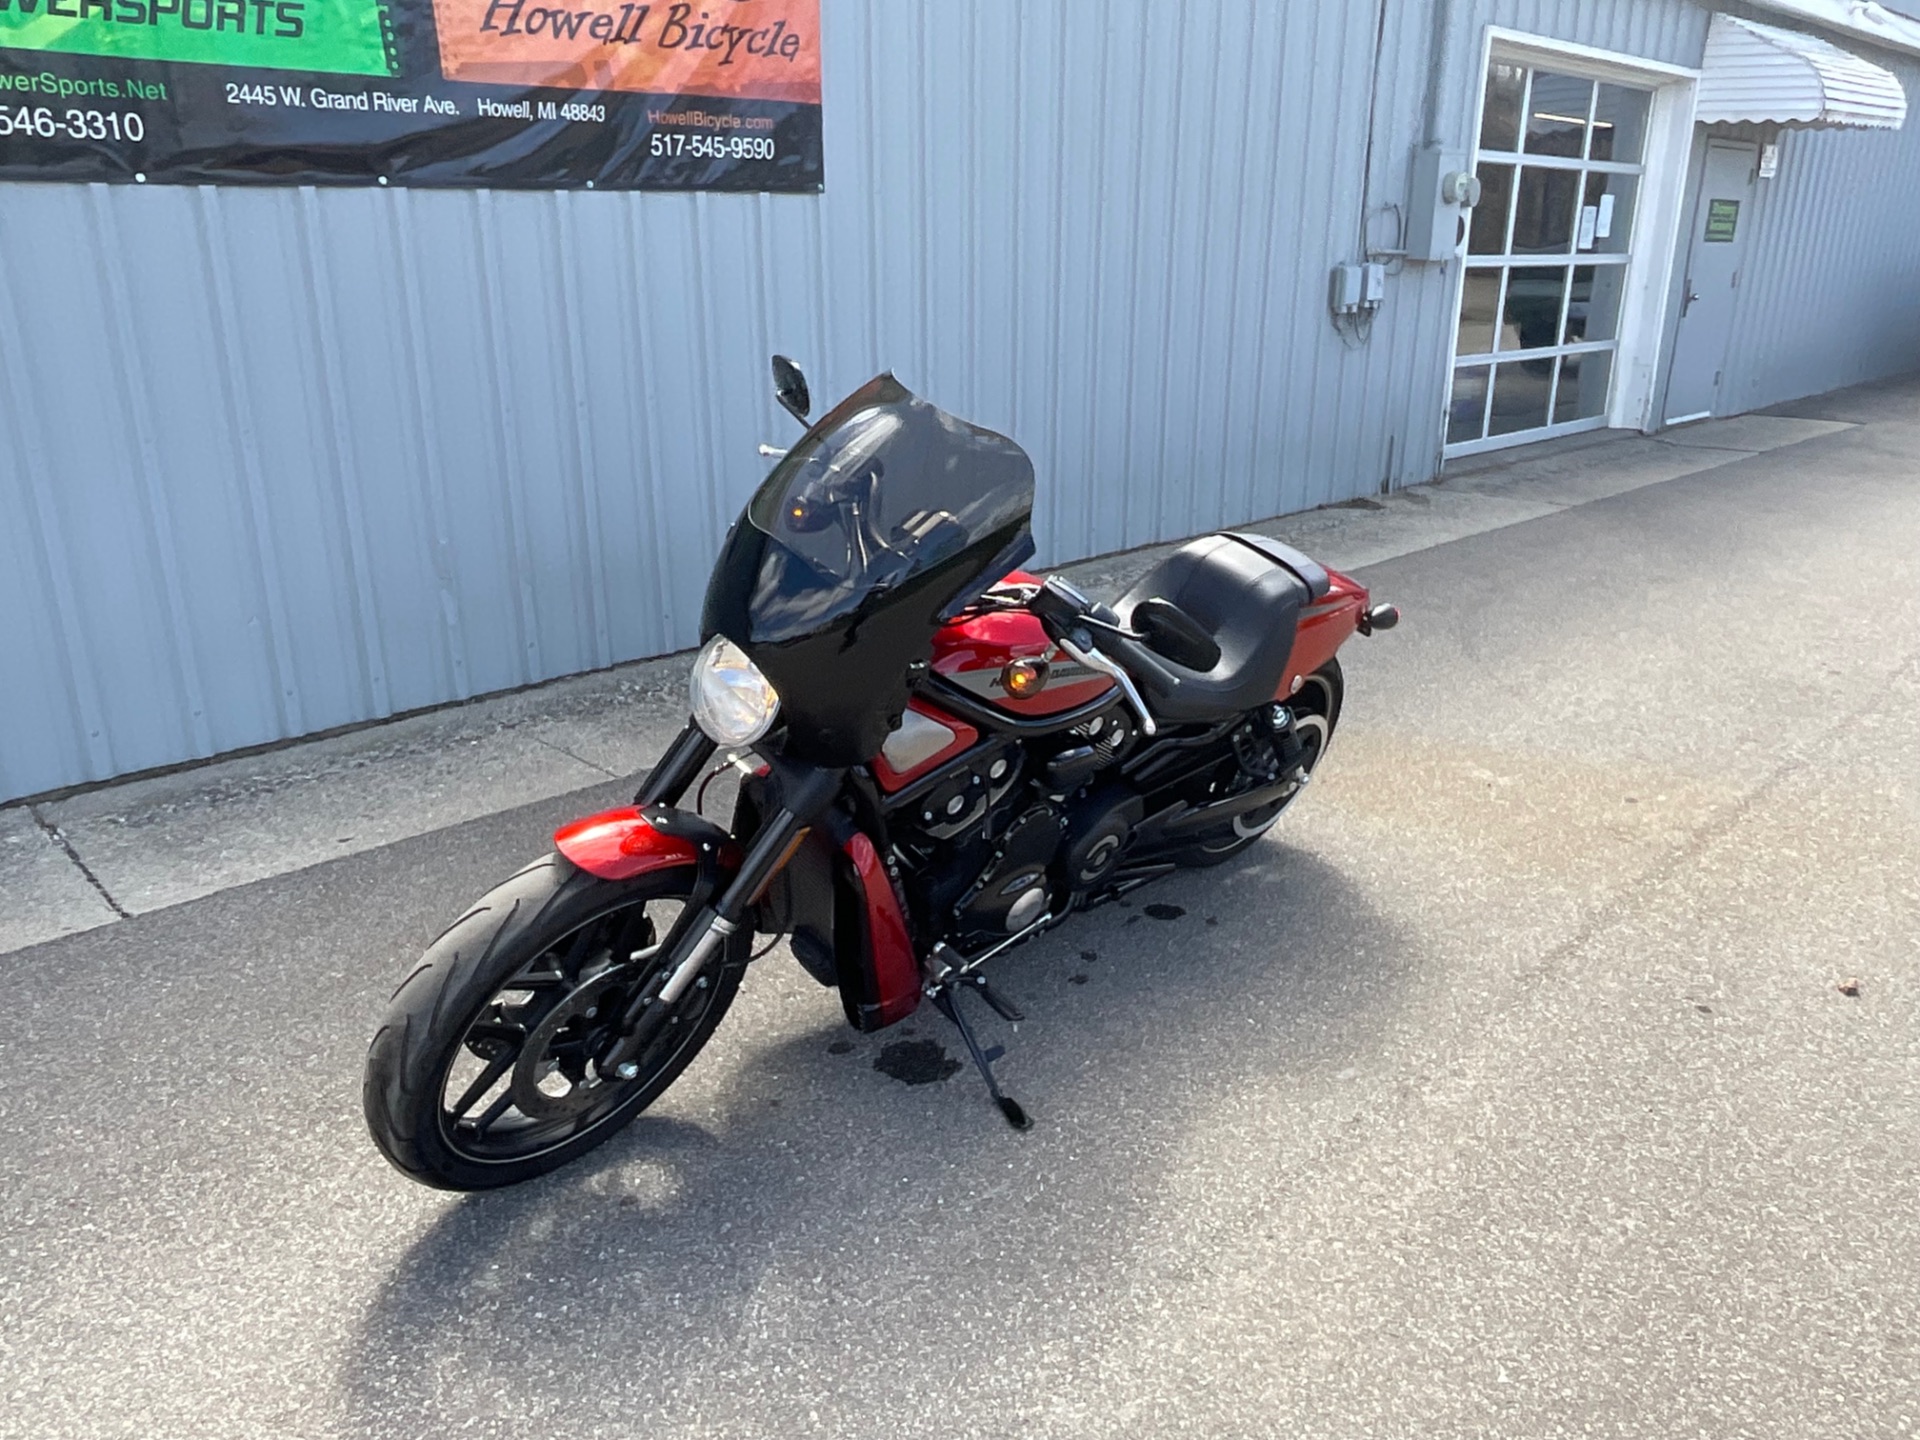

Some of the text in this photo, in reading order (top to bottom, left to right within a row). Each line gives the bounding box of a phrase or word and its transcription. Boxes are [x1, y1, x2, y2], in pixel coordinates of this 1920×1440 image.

[0, 0, 304, 38] ERSPORTS
[480, 0, 801, 66] Howell Bicycle
[225, 83, 606, 123] 2445 W. Grand River Ave. Howell, MI 48843
[647, 109, 774, 131] HowellBicycle.com
[0, 105, 144, 142] 546-3310
[650, 133, 775, 160] 517-545-9590
